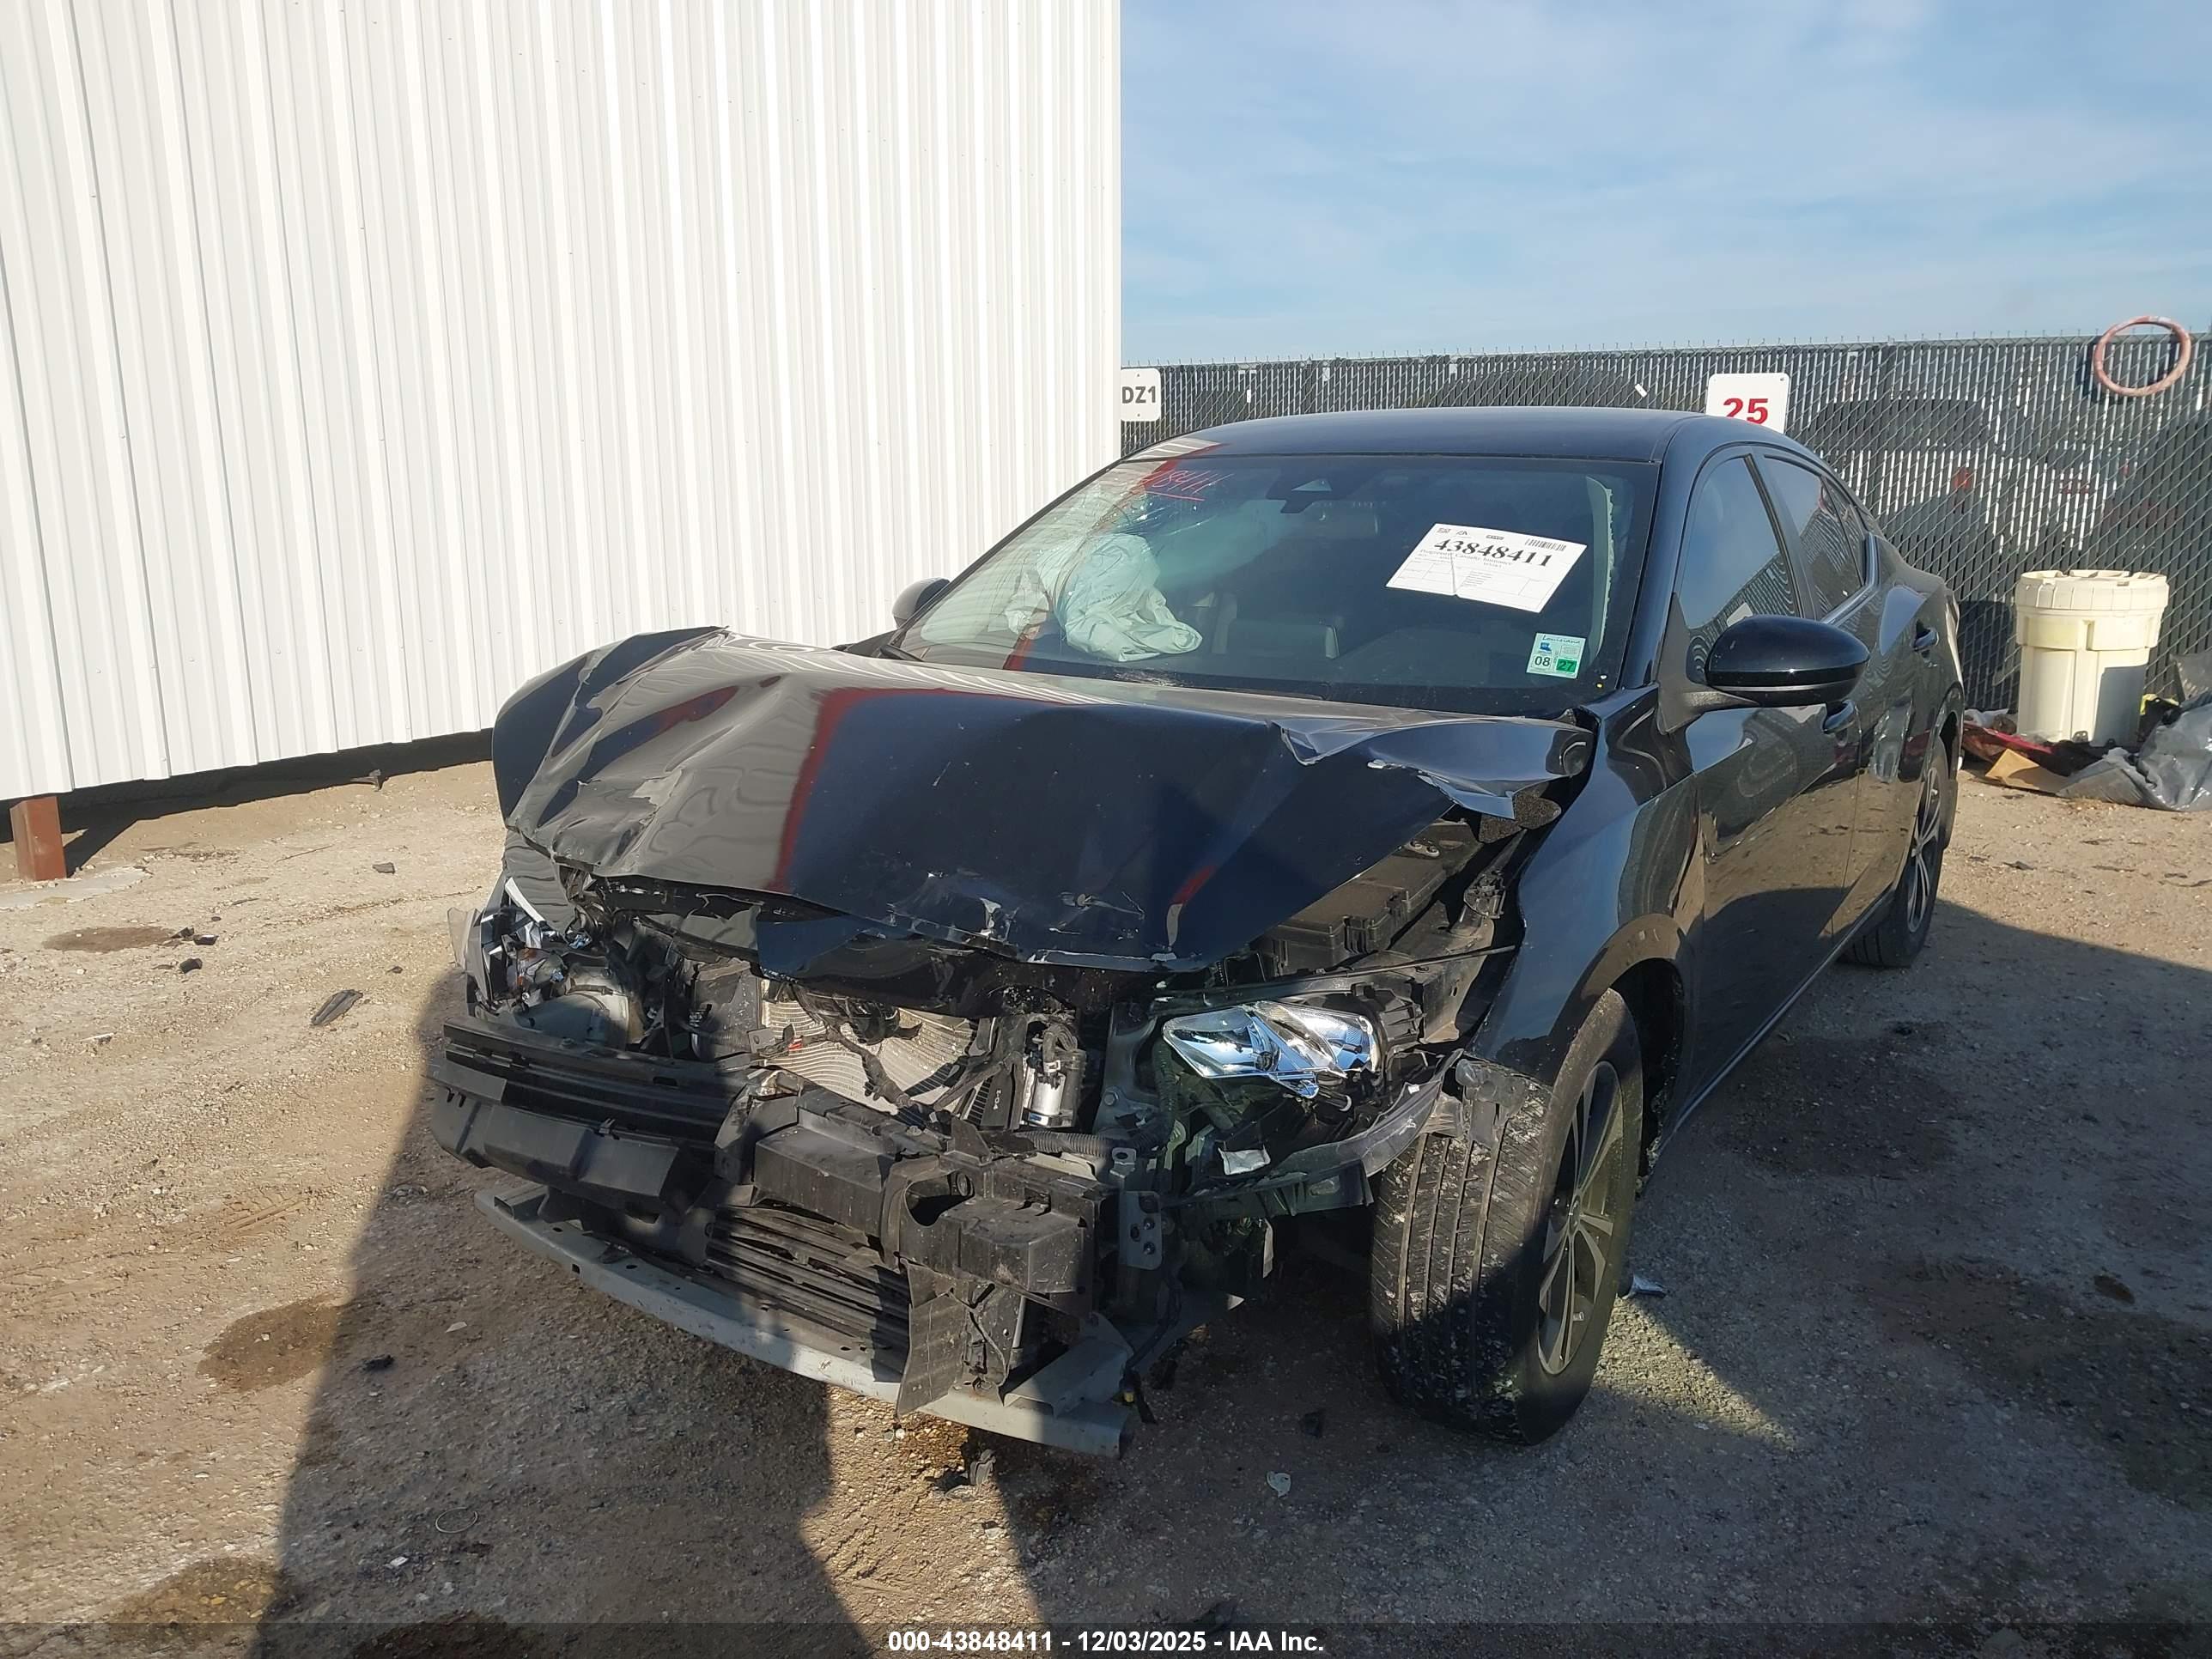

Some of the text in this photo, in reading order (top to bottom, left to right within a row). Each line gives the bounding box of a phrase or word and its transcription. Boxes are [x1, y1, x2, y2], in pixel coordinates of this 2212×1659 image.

[1121, 386, 1156, 404] DZ1
[1723, 398, 1769, 424] 25
[1433, 538, 1553, 567] 43848411
[1534, 656, 1551, 666] 08
[1557, 660, 1574, 671] 27
